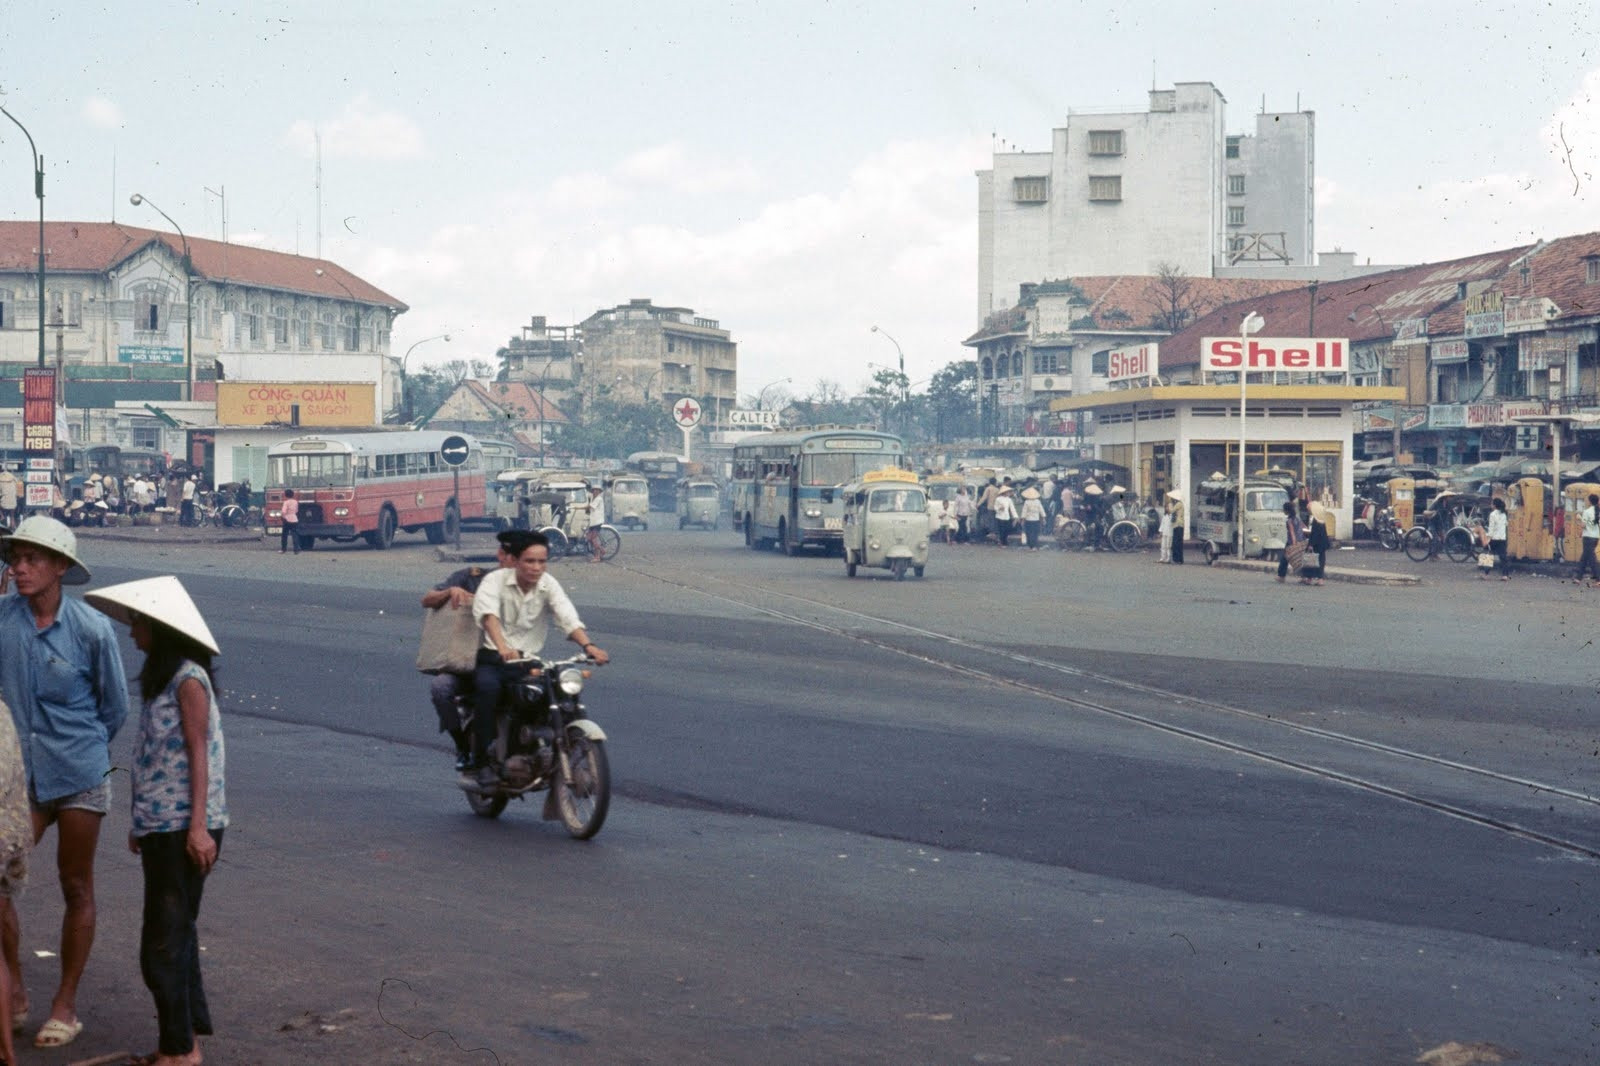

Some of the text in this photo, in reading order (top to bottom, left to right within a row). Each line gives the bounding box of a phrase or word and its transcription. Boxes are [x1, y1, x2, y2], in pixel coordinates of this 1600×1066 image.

[1110, 349, 1148, 377] Shell
[1210, 341, 1342, 367] Shell
[731, 412, 777, 424] CALTEX
[26, 438, 52, 450] nga
